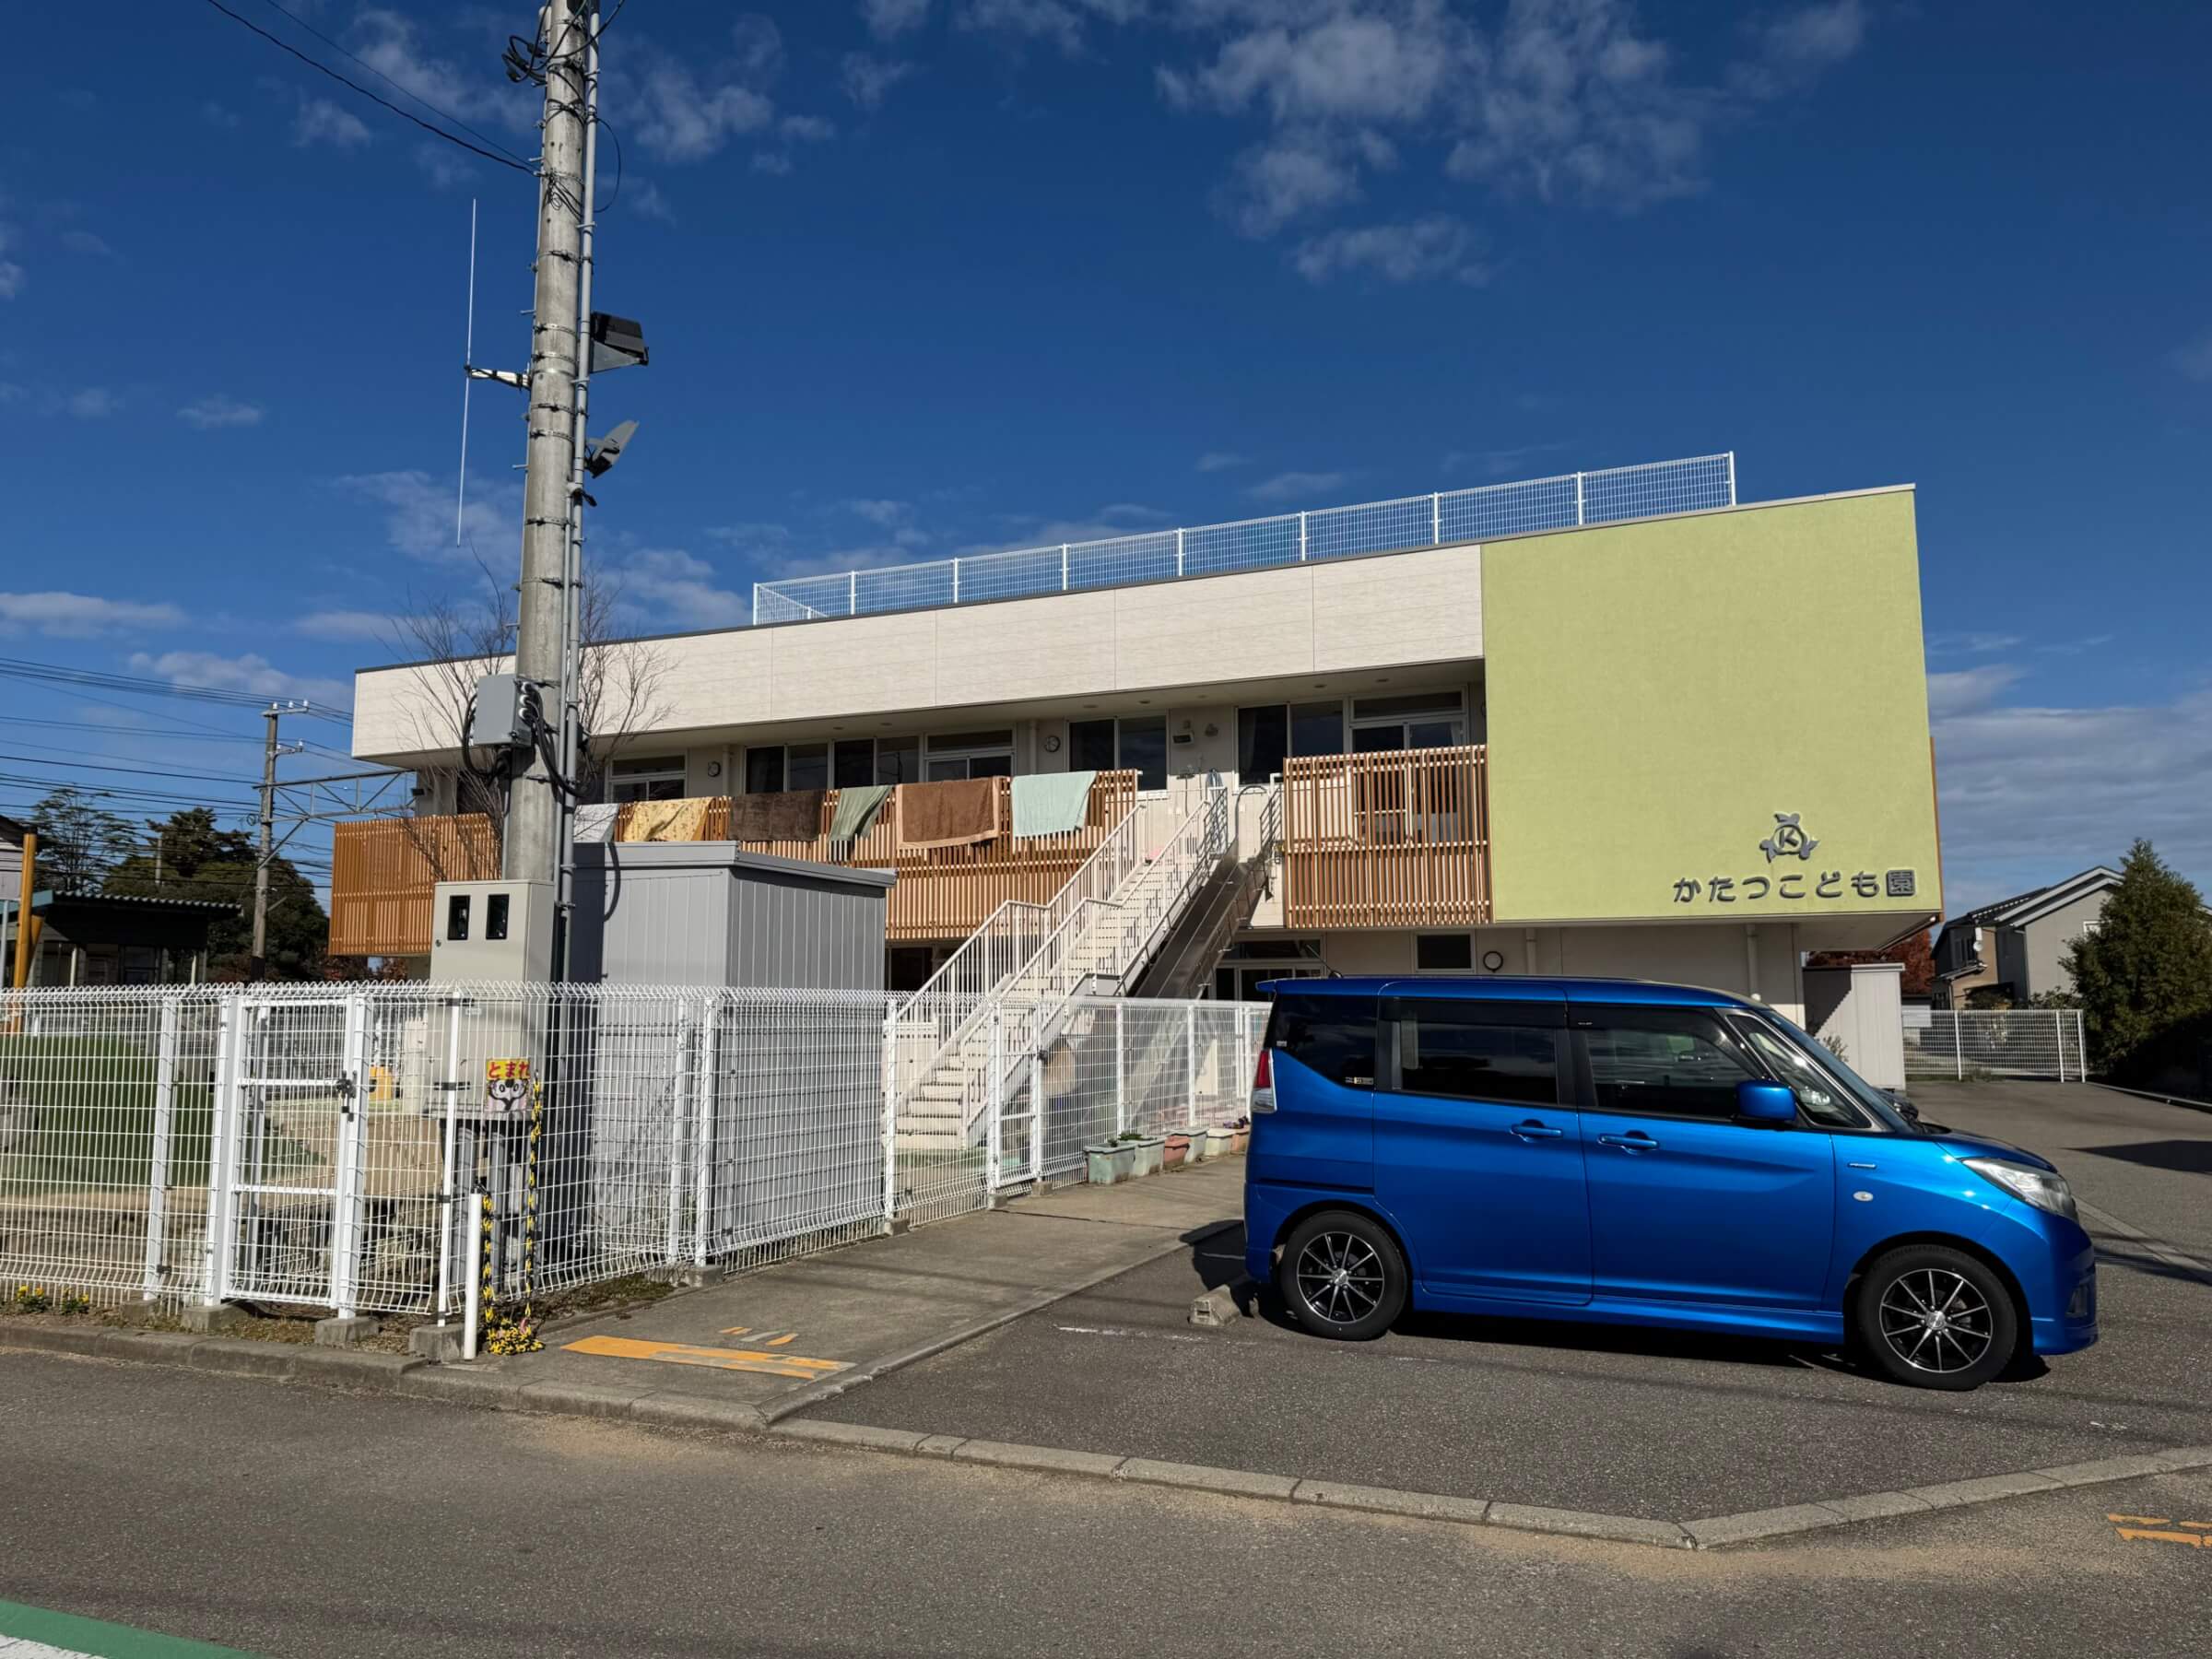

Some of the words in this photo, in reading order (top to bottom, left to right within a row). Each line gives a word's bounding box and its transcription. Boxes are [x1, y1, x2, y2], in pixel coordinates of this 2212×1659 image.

[1779, 828, 1799, 848] K
[1673, 869, 1916, 902] かたつこども園
[488, 1061, 531, 1077] とまれ
